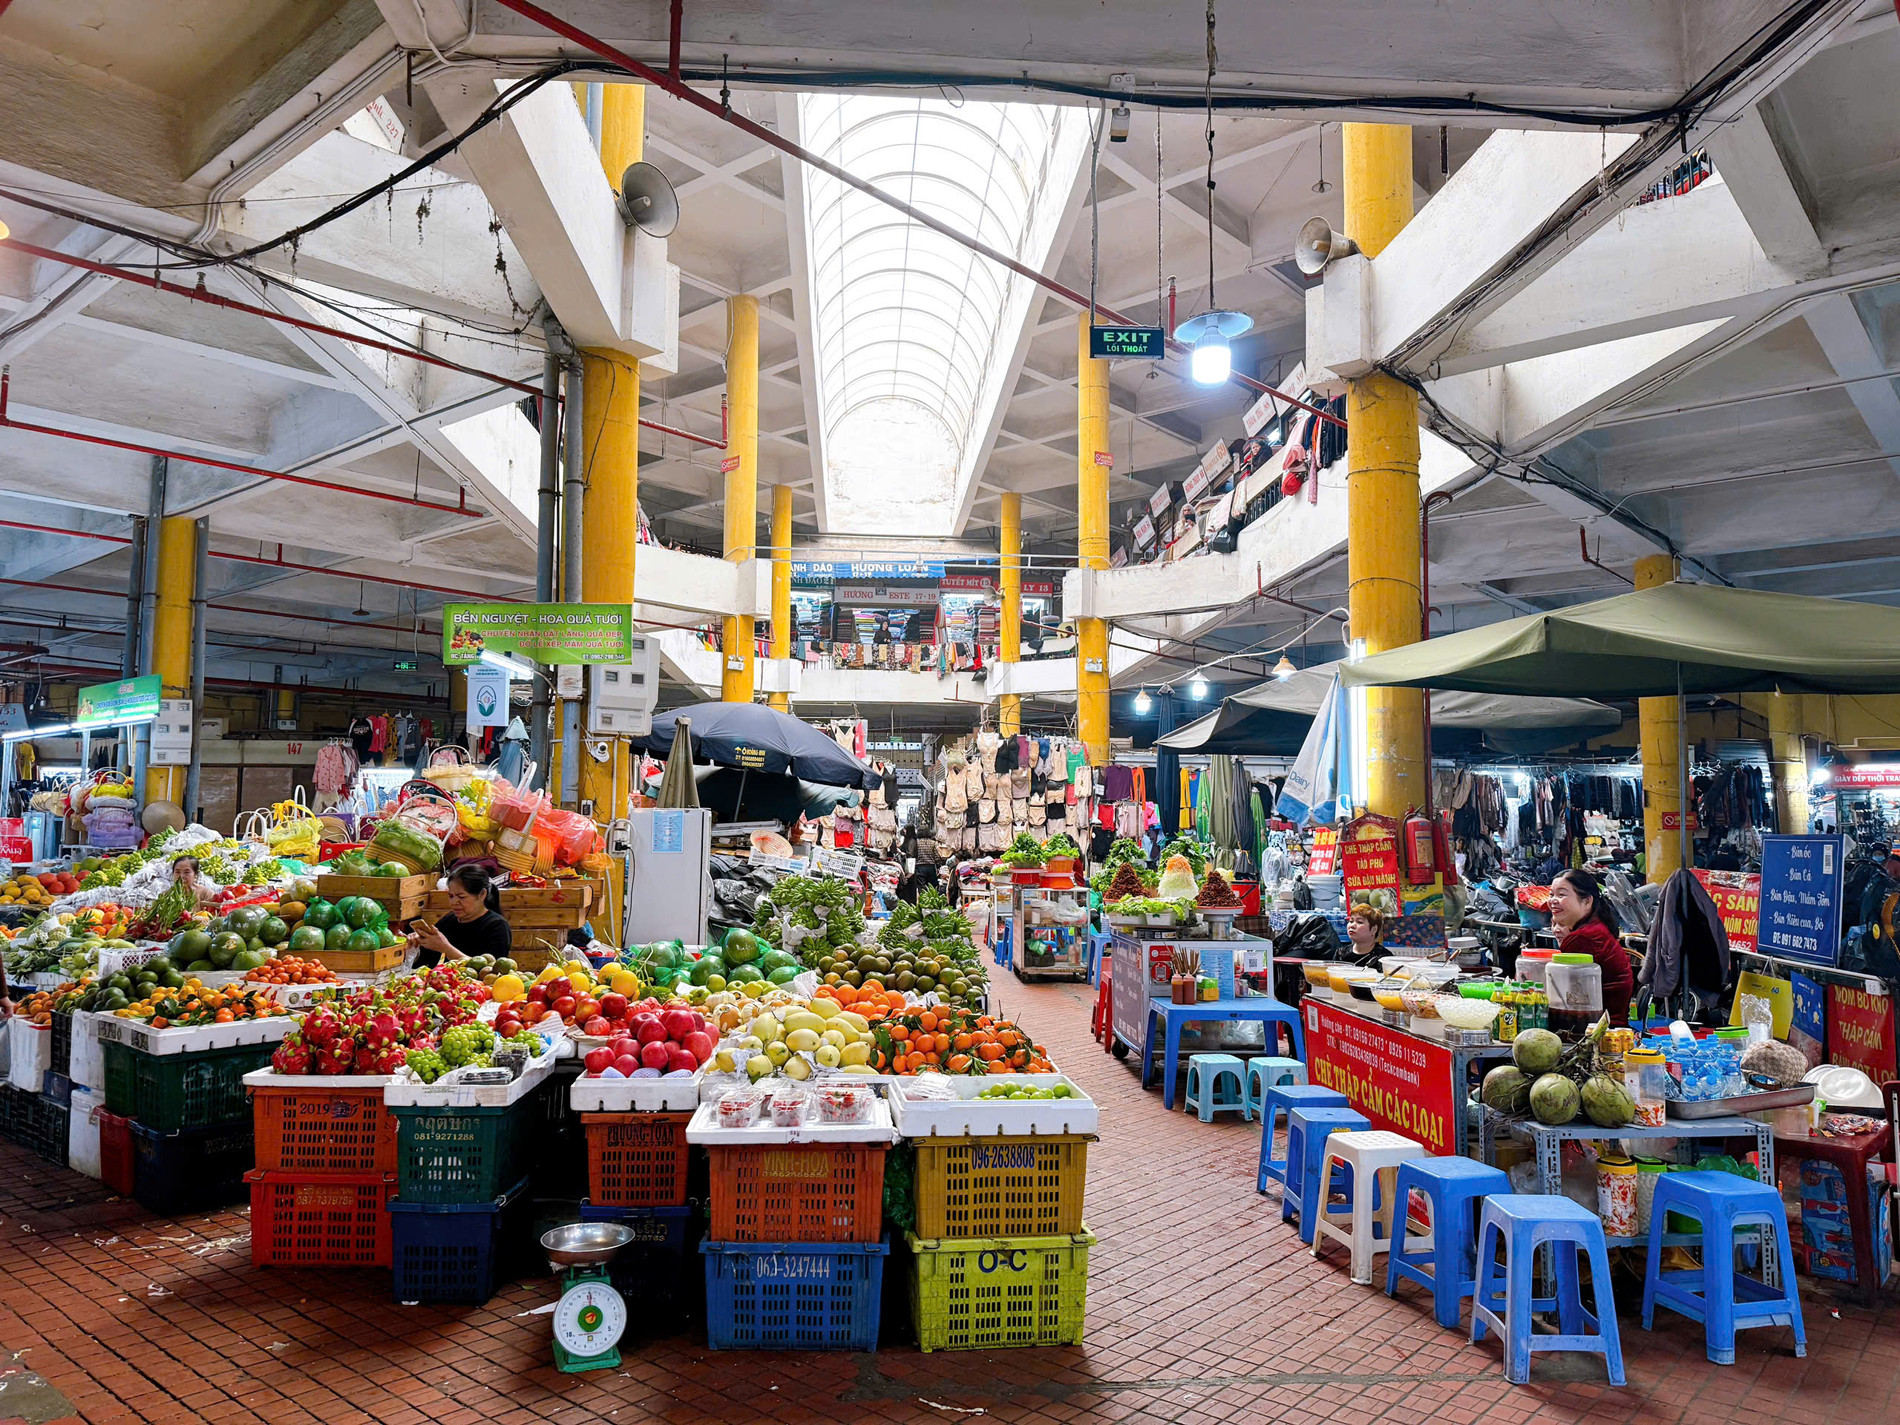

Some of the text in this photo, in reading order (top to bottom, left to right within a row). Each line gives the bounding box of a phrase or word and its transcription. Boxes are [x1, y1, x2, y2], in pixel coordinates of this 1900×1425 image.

[1103, 332, 1151, 342] EXIT
[539, 614, 565, 624] HOA
[566, 612, 593, 624] QUẢ
[594, 613, 622, 624] TƯƠI
[287, 743, 302, 755] 147
[1289, 771, 1310, 790] Dairy
[1726, 890, 1758, 912] SẢN
[1503, 1013, 1515, 1026] C2
[1368, 1033, 1385, 1052] 27473
[1388, 1041, 1402, 1059] 0926
[1411, 1049, 1427, 1069] 5239
[300, 1102, 331, 1115] 2019
[1314, 1055, 1444, 1151] CHÈ THẬP CẨM CÁC LOẠI
[971, 1145, 1035, 1170] 096-2638808
[978, 1249, 1027, 1274] O-C
